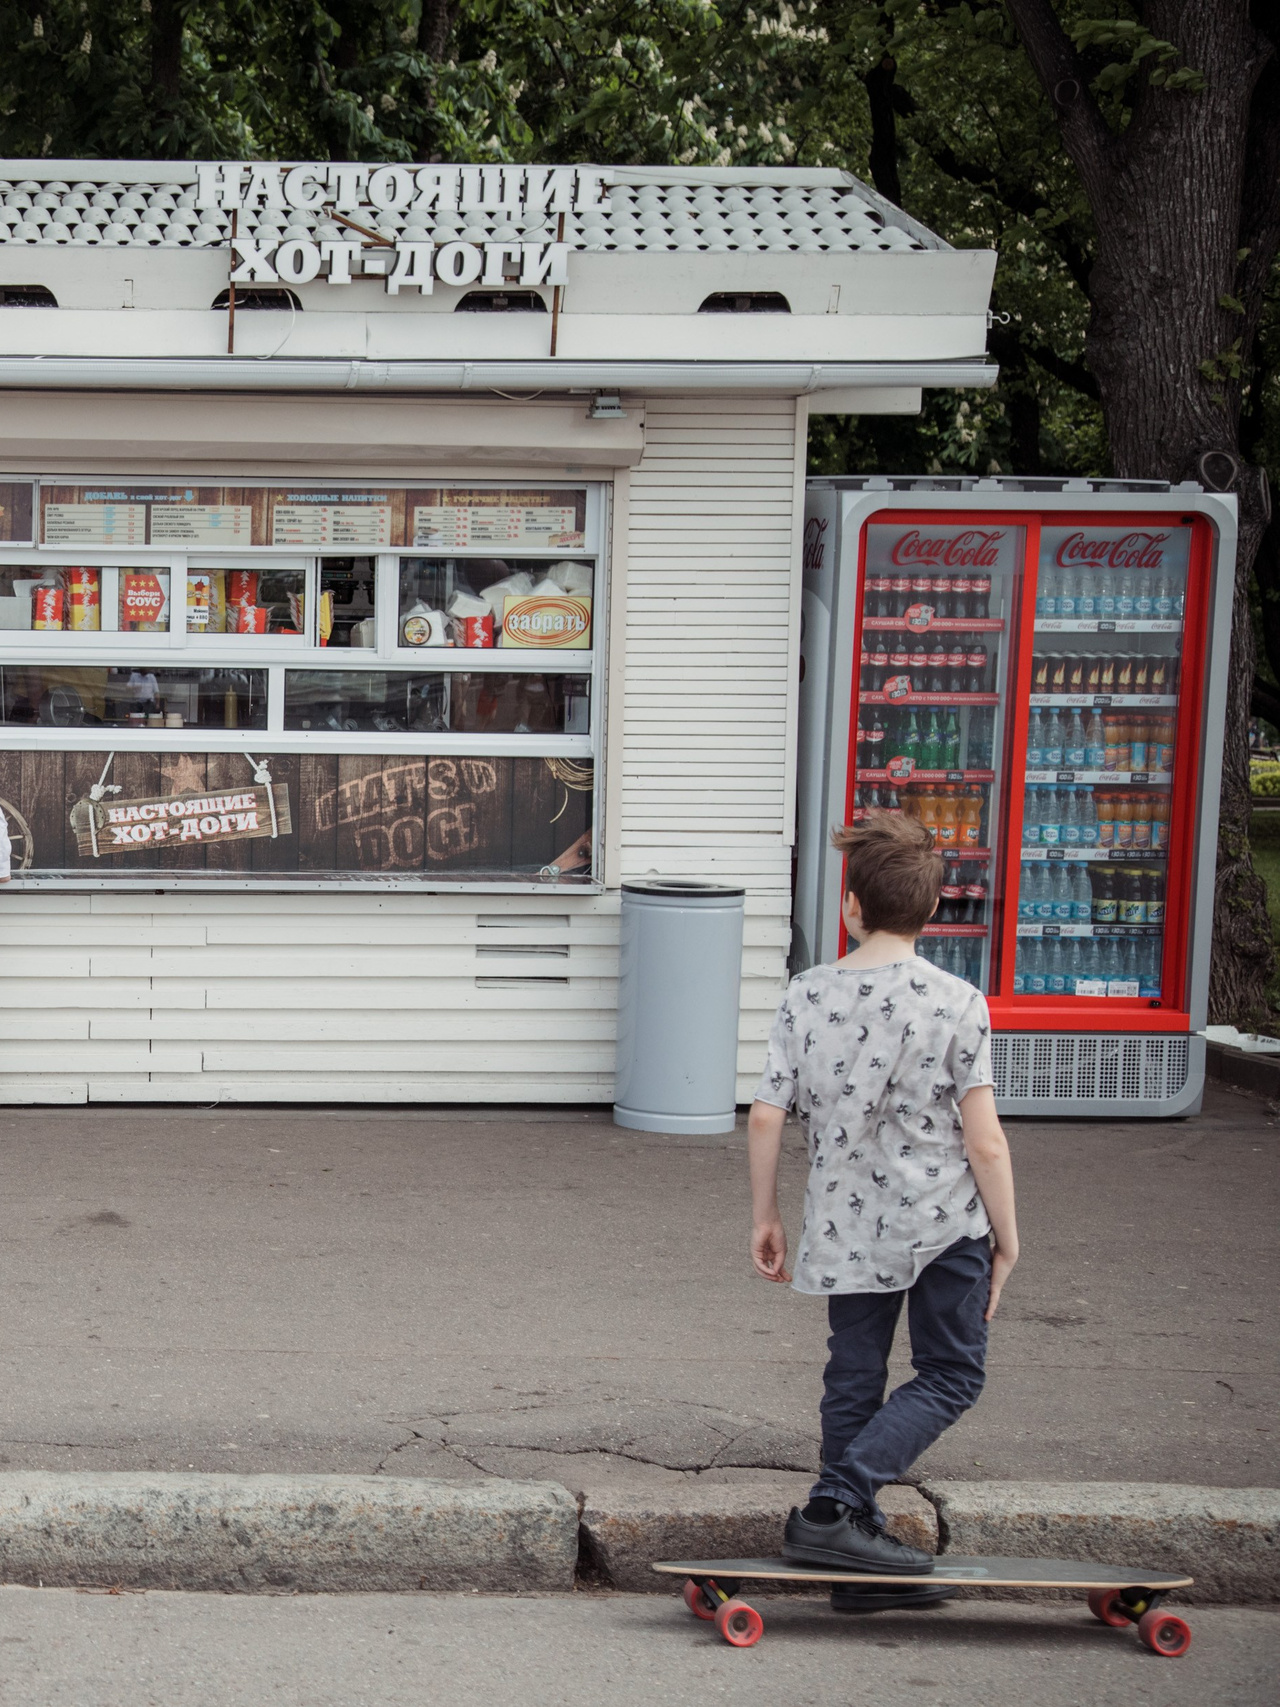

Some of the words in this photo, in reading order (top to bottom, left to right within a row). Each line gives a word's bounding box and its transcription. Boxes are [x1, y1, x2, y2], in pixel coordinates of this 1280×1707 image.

[195, 165, 614, 221] НАСТОЯЩИЕ
[229, 238, 570, 295] ХОТ-ДОГИ
[891, 530, 1008, 567] Coca-Cola
[1055, 531, 1171, 569] Coca-Cola
[126, 596, 160, 607] СОУС
[127, 589, 160, 597] Выбери
[508, 611, 585, 633] забрать
[107, 793, 257, 823] НАСТОЯЩИЕ
[111, 811, 260, 844] ХОТ-ДОГИ
